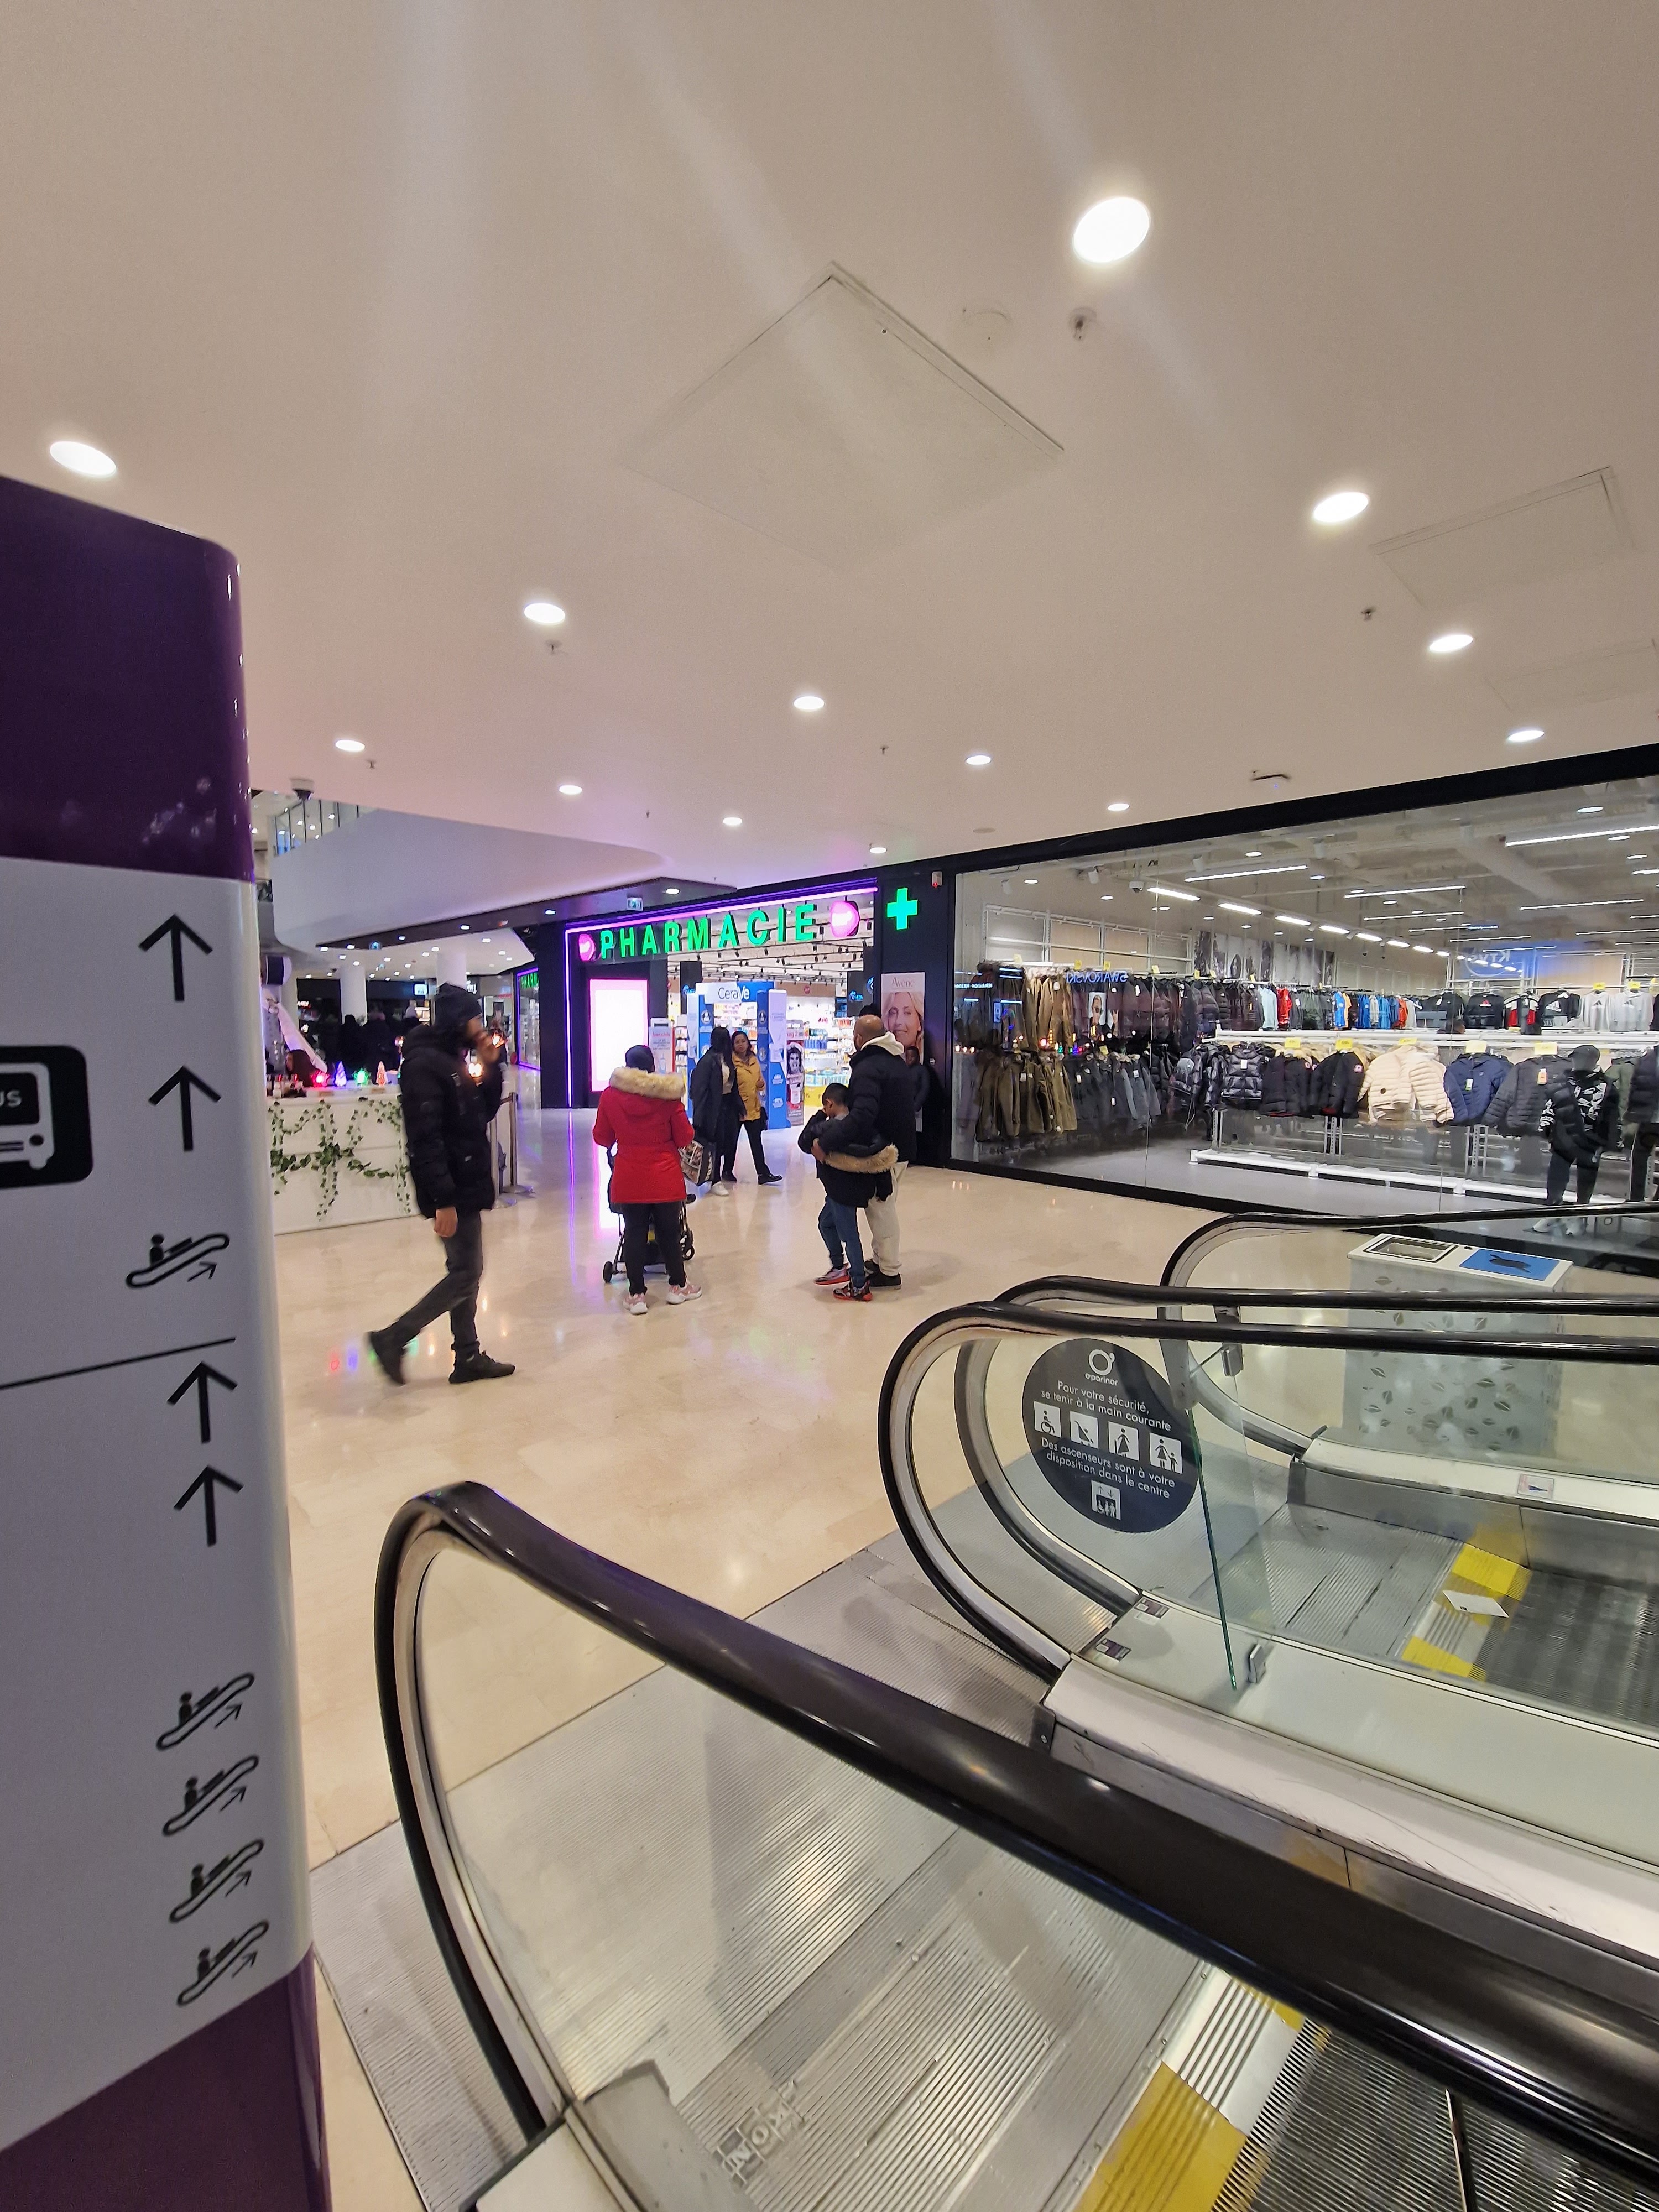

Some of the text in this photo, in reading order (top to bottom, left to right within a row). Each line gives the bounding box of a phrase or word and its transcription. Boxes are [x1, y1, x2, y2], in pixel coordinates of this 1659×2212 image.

[600, 903, 816, 959] PHARMACIE
[718, 985, 750, 1000] CeraVe
[1041, 1390, 1171, 1432] se tenir à la main courante
[1057, 1380, 1150, 1415] Pour votre sécurité,
[1042, 1438, 1175, 1488] Des ascenseurs sont à votre
[1046, 1451, 1170, 1499] disposition dans le centre
